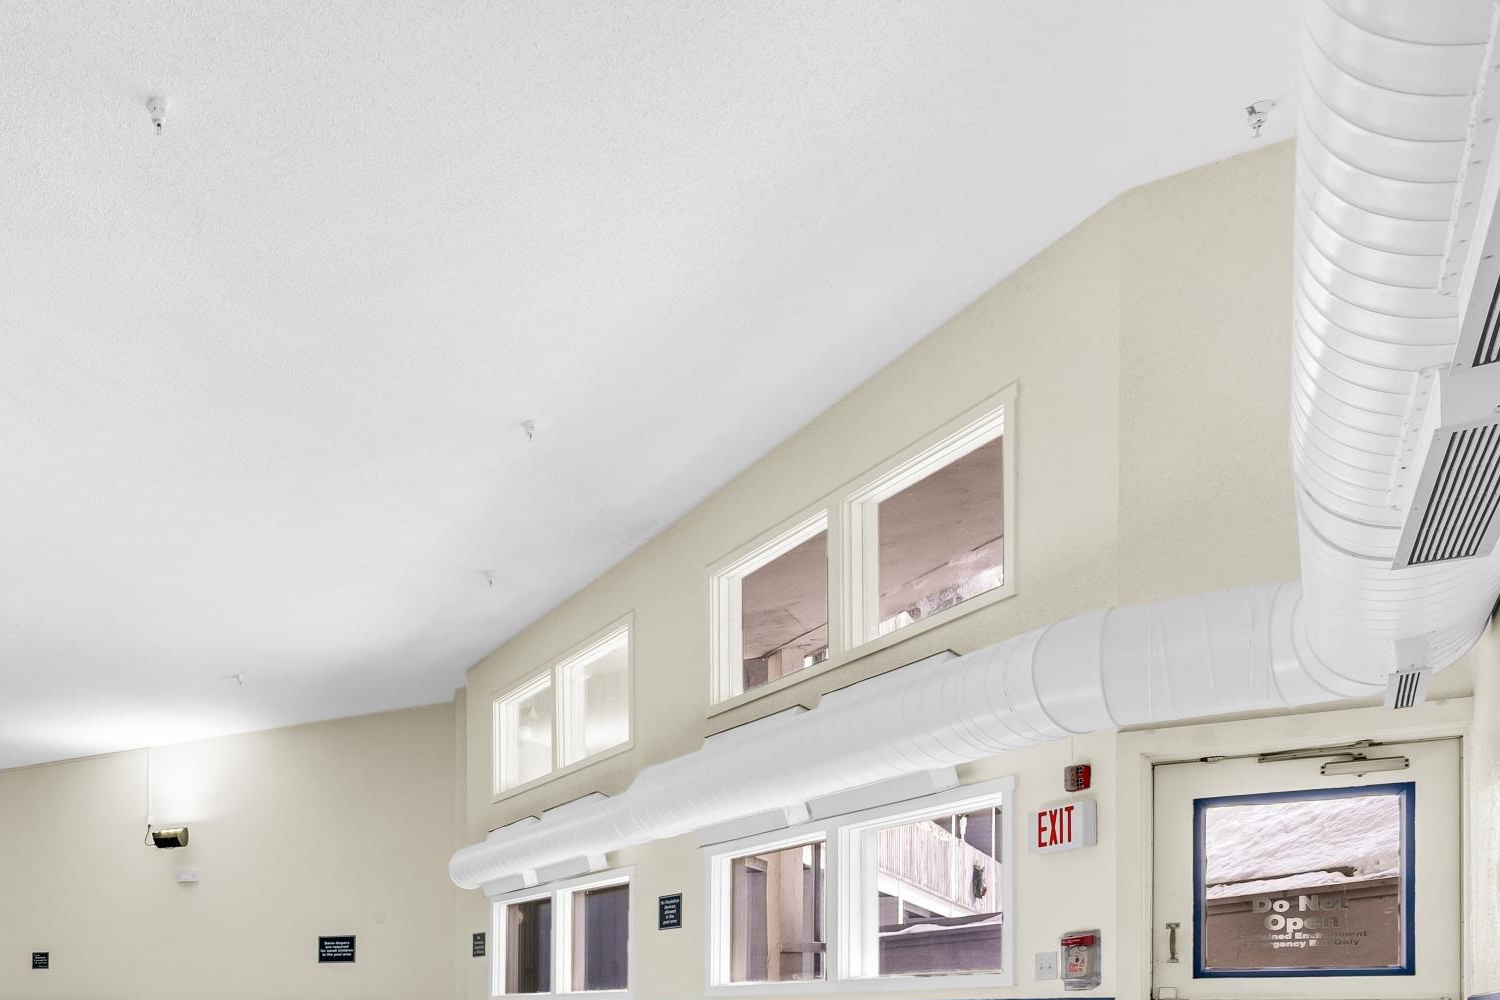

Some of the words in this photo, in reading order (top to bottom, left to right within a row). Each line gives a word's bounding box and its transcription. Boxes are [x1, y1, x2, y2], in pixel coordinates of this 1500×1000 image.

[1037, 805, 1075, 848] EXIT
[1252, 897, 1290, 914] Do
[1298, 894, 1348, 912] Not
[1264, 913, 1340, 933] Open
